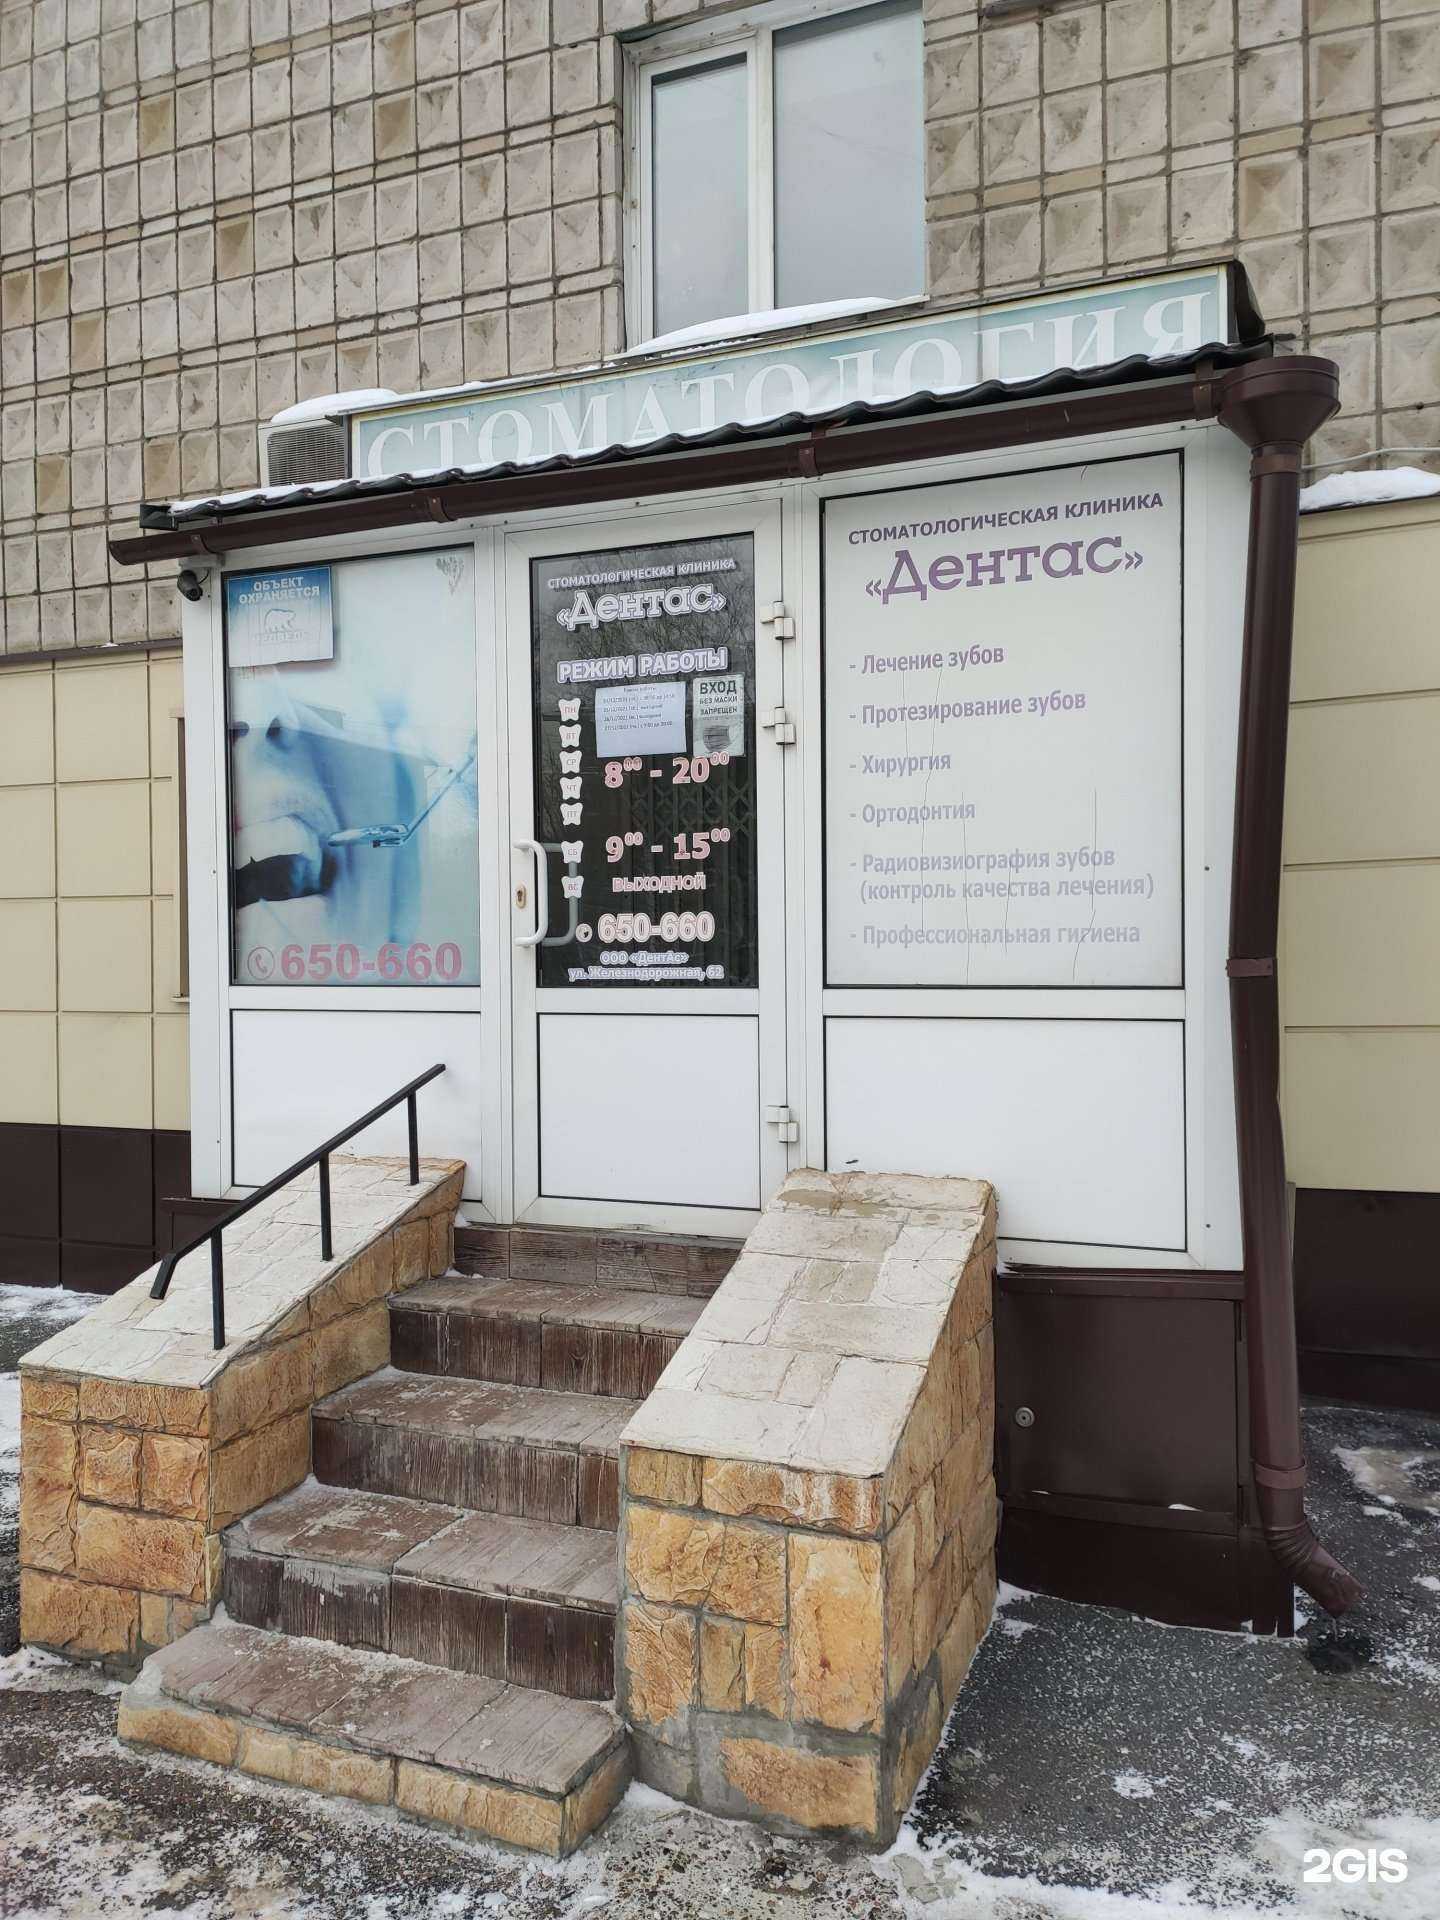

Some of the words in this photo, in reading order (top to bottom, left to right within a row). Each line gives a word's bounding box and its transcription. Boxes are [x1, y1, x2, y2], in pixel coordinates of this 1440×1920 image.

[367, 291, 1211, 478] СТОМАТОЛОГИЯ
[849, 506, 1058, 545] СТОМАТОЛОГИЧЕСКАЯ
[1065, 492, 1164, 519] КЛИНИКА
[253, 577, 304, 591] ОБЪЕКТ
[548, 566, 675, 588] СТОМАТОЛОГИЧЕСКАЯ
[677, 558, 736, 577] КЛИНИКА
[865, 535, 1144, 605] «Дентас»
[238, 586, 320, 604] ОХРАНЯЕТСЯ
[557, 583, 727, 631] «Дентас»
[557, 655, 635, 683] РЕЖИМ
[638, 647, 728, 676] РАБОТЫ
[862, 650, 943, 674] Лечение
[948, 644, 1004, 671] зубов
[700, 680, 737, 695] ВХОД
[714, 696, 737, 704] МАСКИ
[564, 706, 576, 714] ПН
[862, 693, 1023, 727] Протезирование
[1027, 690, 1086, 716] зубов
[862, 752, 951, 777] Хирургия
[862, 802, 976, 827] Ортодонтия
[567, 848, 577, 856] СБ
[863, 849, 1050, 874] Радиовизиография
[1056, 846, 1115, 871] зубов
[860, 880, 956, 904] (контроль
[962, 878, 1050, 898] качества
[1056, 873, 1154, 899] лечения)
[598, 910, 715, 943] 650-660
[863, 925, 1050, 948] Профессиональная
[1057, 923, 1140, 944] гигиена
[281, 942, 462, 981] 650-660
[600, 951, 629, 965] ООО
[568, 968, 587, 982] ул.
[588, 966, 705, 982] Железнодорожная,
